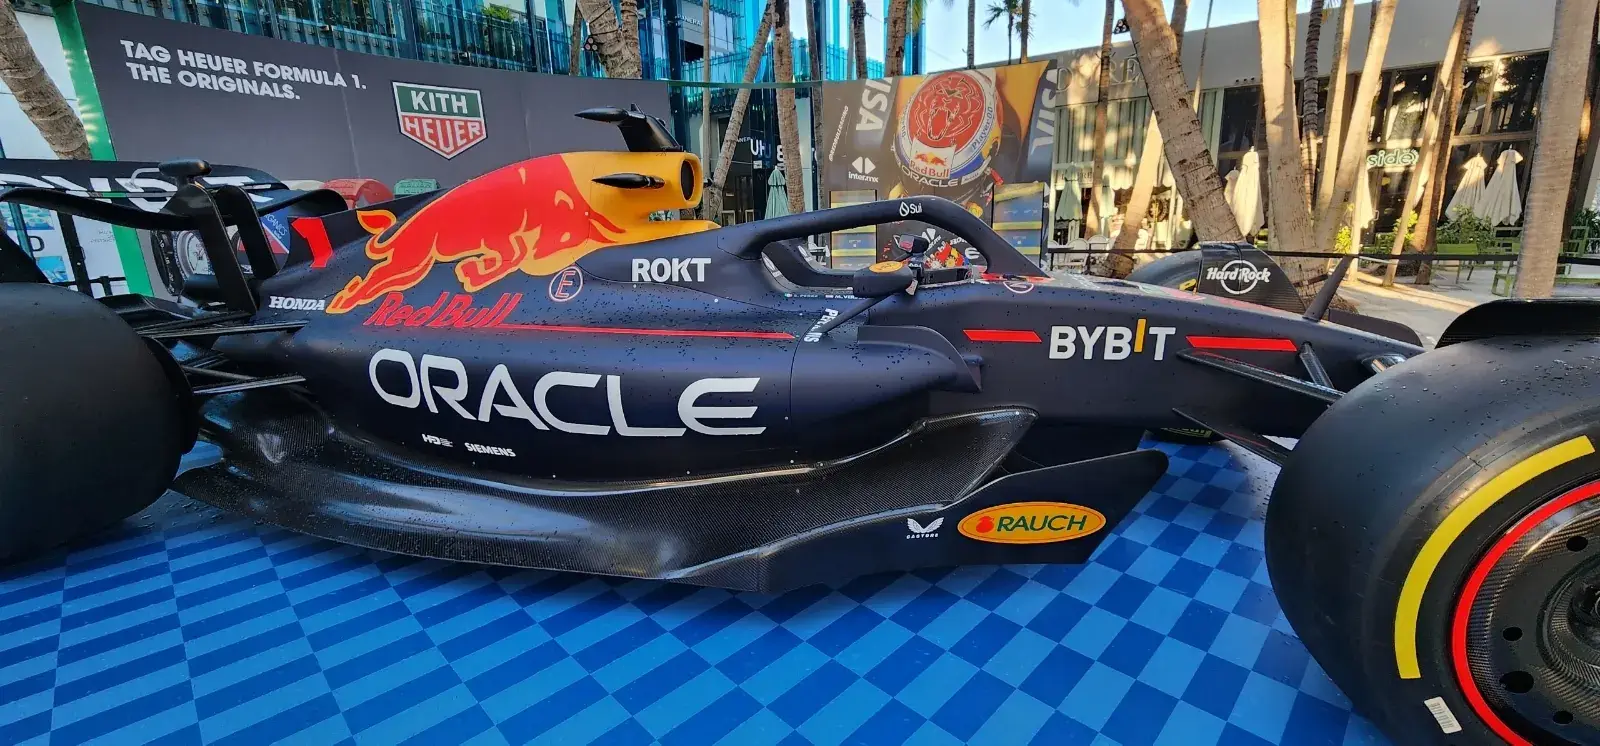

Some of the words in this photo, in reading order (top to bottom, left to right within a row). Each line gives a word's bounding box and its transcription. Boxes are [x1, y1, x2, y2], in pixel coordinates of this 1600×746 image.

[119, 39, 171, 63] TAG
[177, 49, 249, 75] HEUER
[253, 61, 347, 88] FORMULA
[351, 74, 367, 90] 1.
[125, 61, 172, 85] THE
[177, 70, 301, 100] ORIGINALS.
[410, 90, 468, 114] KITH
[856, 77, 893, 131] ISA
[404, 117, 481, 152] HEUER
[901, 164, 959, 188] ORACLE
[631, 257, 712, 283] ROKT
[1206, 266, 1239, 281] Hard
[1239, 267, 1271, 283] Rock
[268, 295, 326, 311] HONDA
[1048, 318, 1176, 361] BYBIT
[368, 348, 767, 437] ORACLE
[464, 442, 517, 457] SIEMENS
[997, 514, 1088, 533] RAUCH
